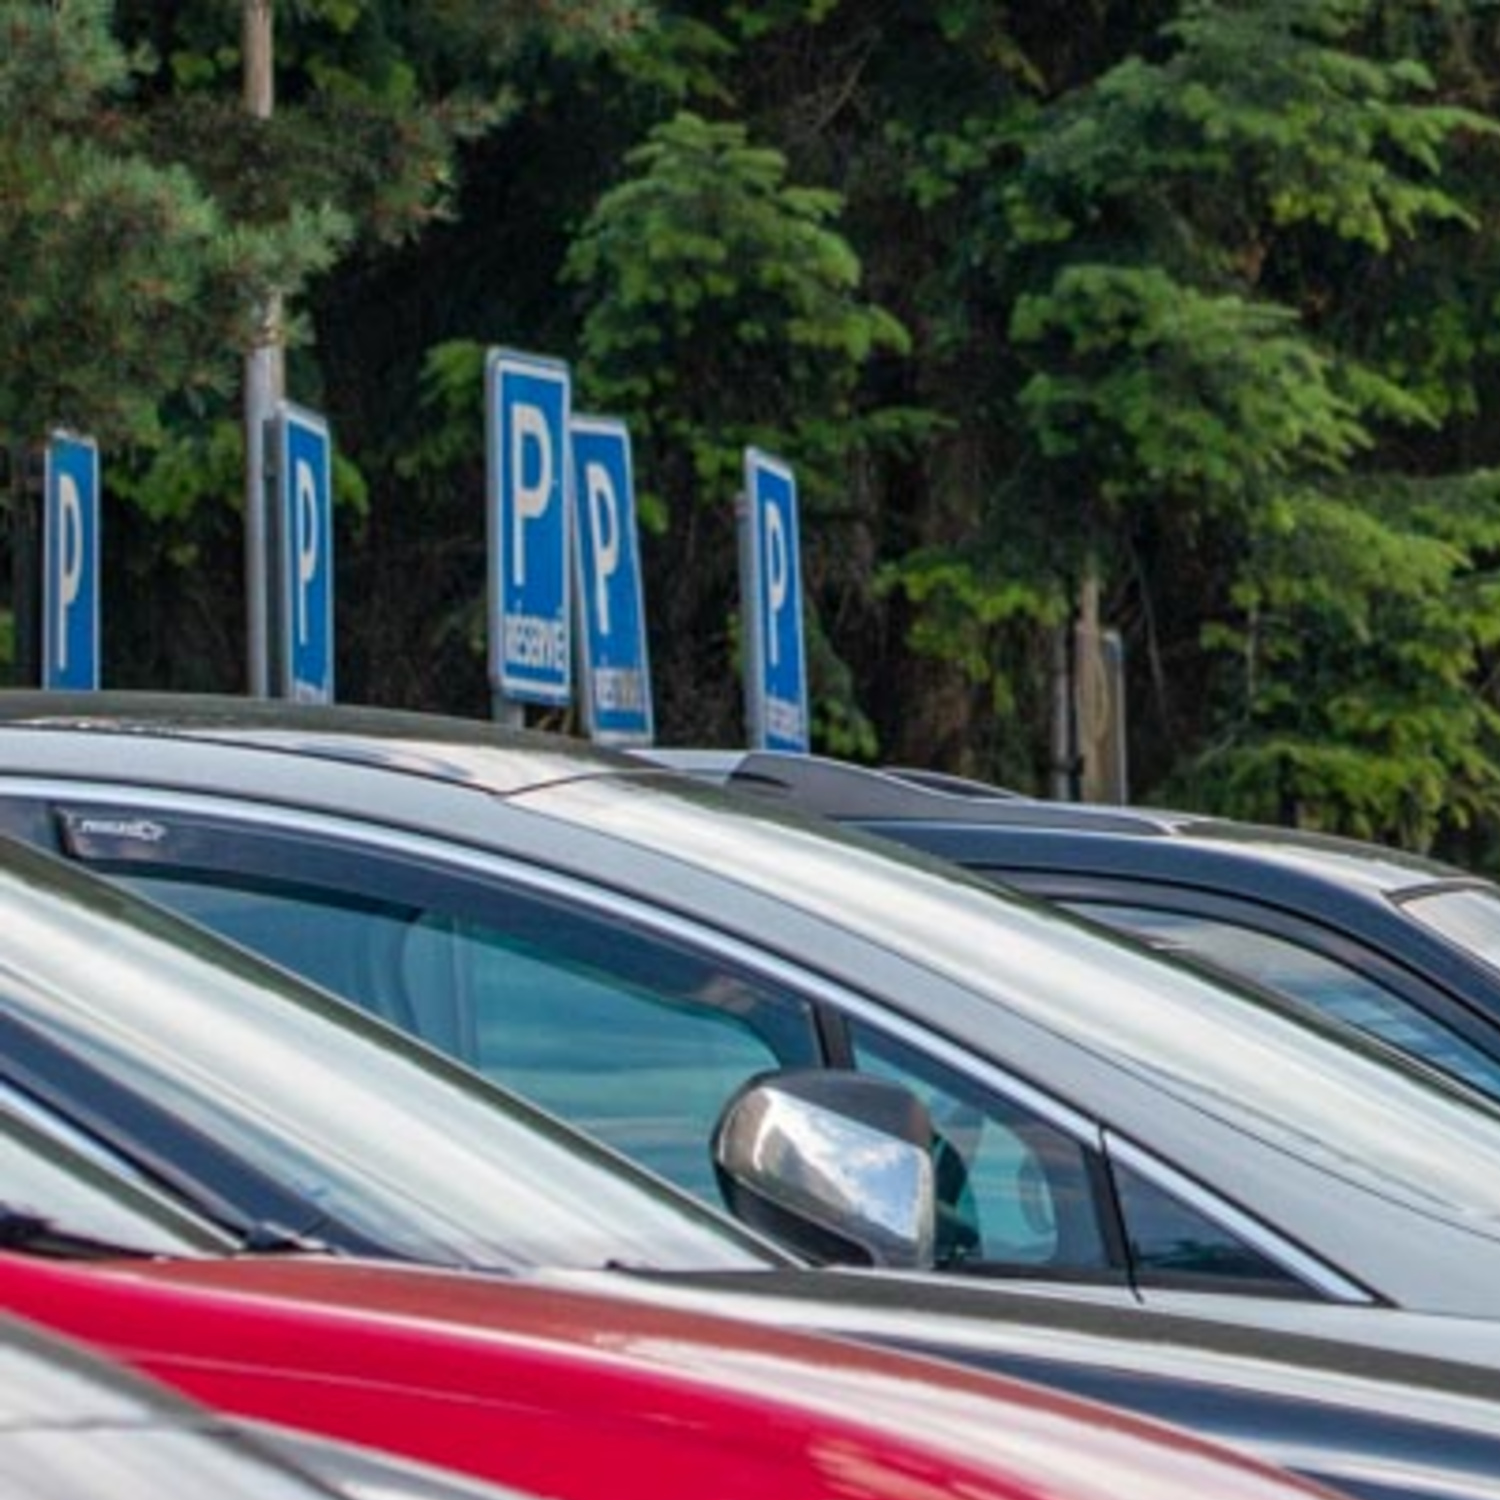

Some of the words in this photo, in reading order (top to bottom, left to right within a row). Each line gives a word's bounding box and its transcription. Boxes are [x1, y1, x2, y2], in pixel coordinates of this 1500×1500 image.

[58, 474, 83, 671] P
[296, 457, 318, 646] P
[511, 402, 552, 587] P
[586, 462, 620, 636] P
[765, 499, 788, 667] P
